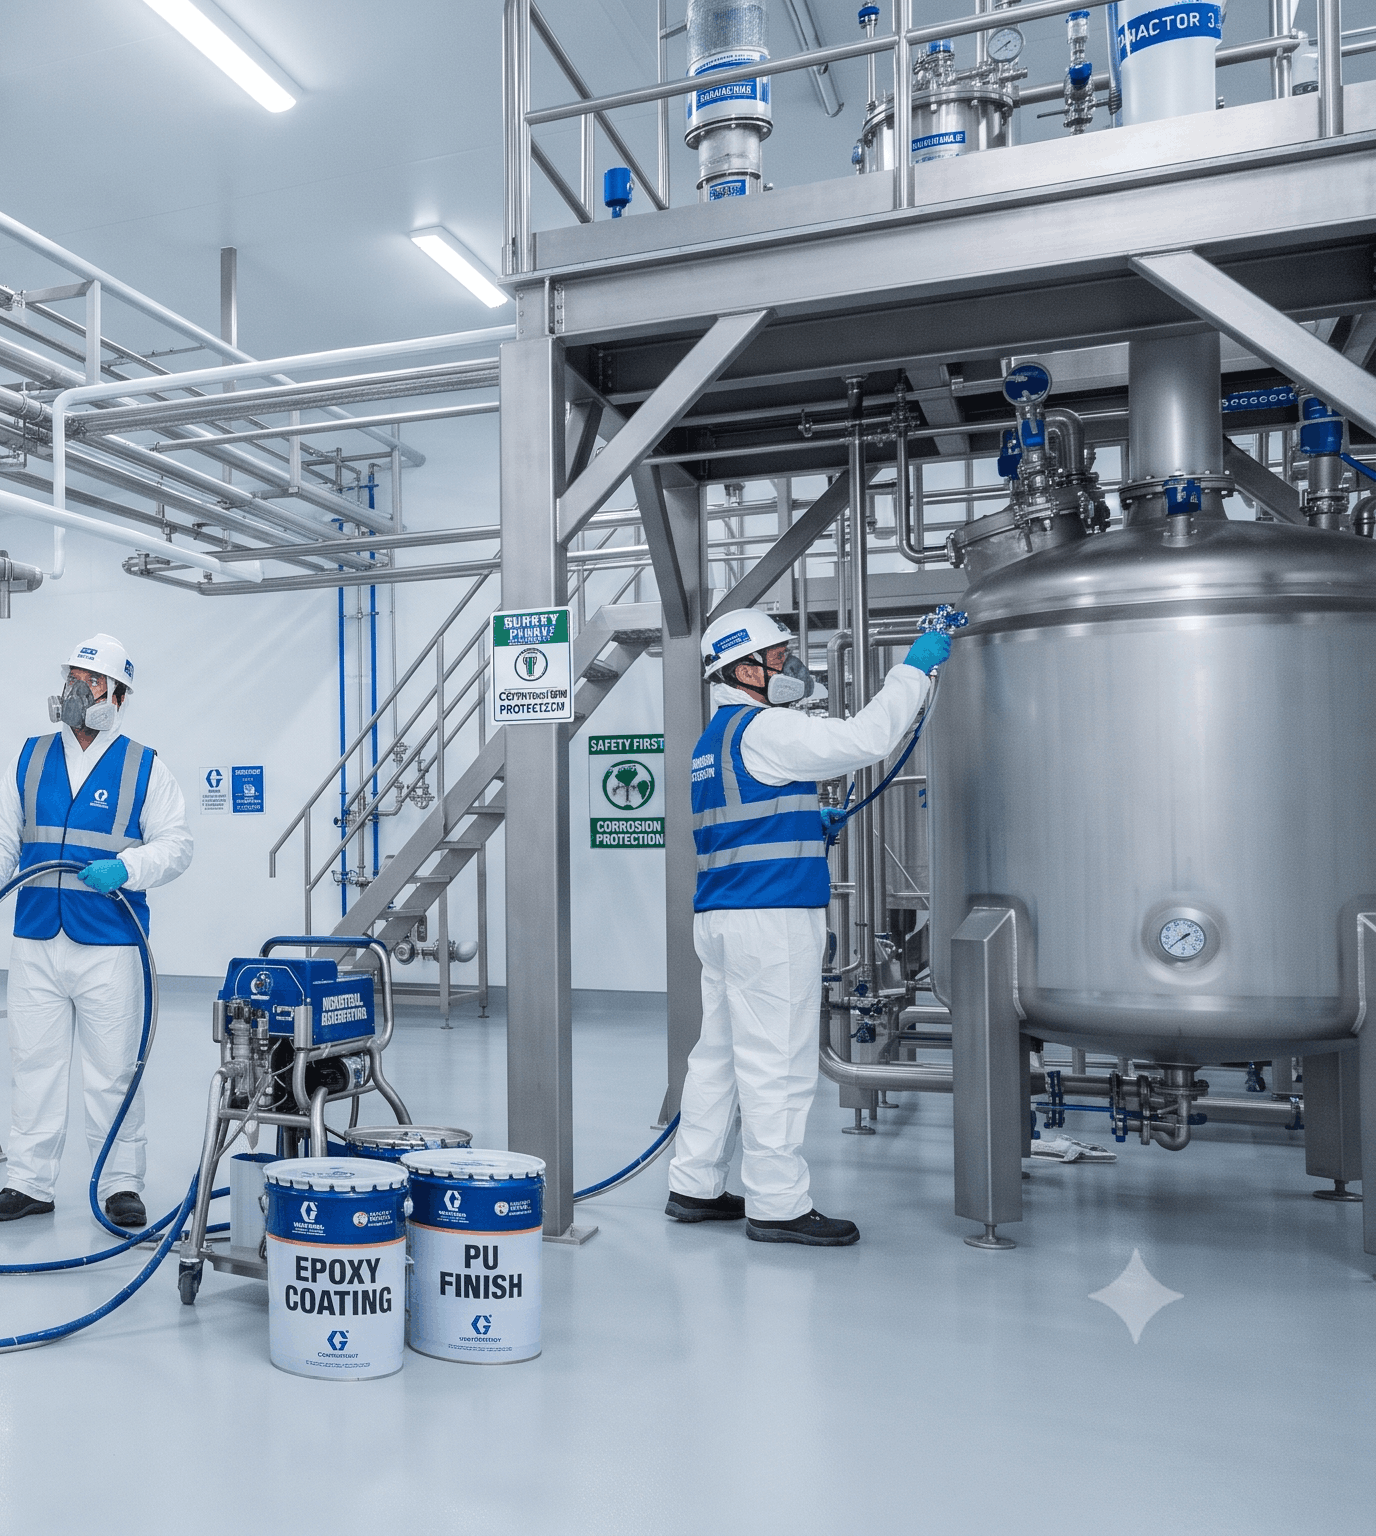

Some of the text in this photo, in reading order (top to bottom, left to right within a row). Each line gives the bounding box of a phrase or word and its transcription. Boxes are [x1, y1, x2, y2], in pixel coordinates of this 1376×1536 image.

[590, 738, 664, 752] SAFETY FIRST
[596, 820, 661, 832] CORROSION
[596, 833, 664, 845] PROTECTION
[295, 1255, 381, 1285] EPOXY
[464, 1244, 499, 1271] PU
[439, 1270, 522, 1300] FINISH
[285, 1284, 392, 1316] COATING
